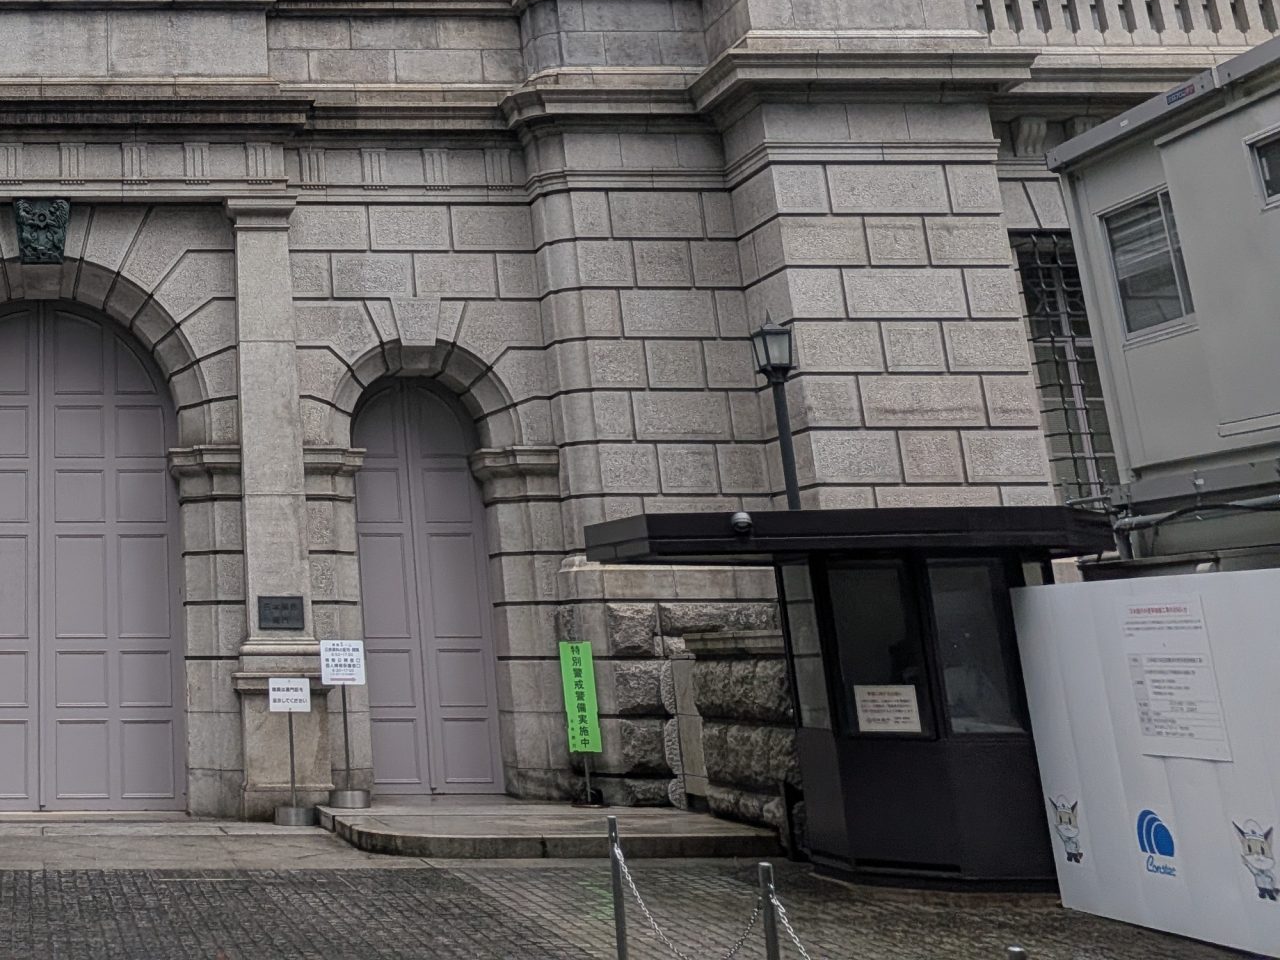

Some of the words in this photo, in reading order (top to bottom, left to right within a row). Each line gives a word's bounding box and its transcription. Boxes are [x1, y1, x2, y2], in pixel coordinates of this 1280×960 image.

[570, 645, 590, 748] 特別警戒警備実施中
